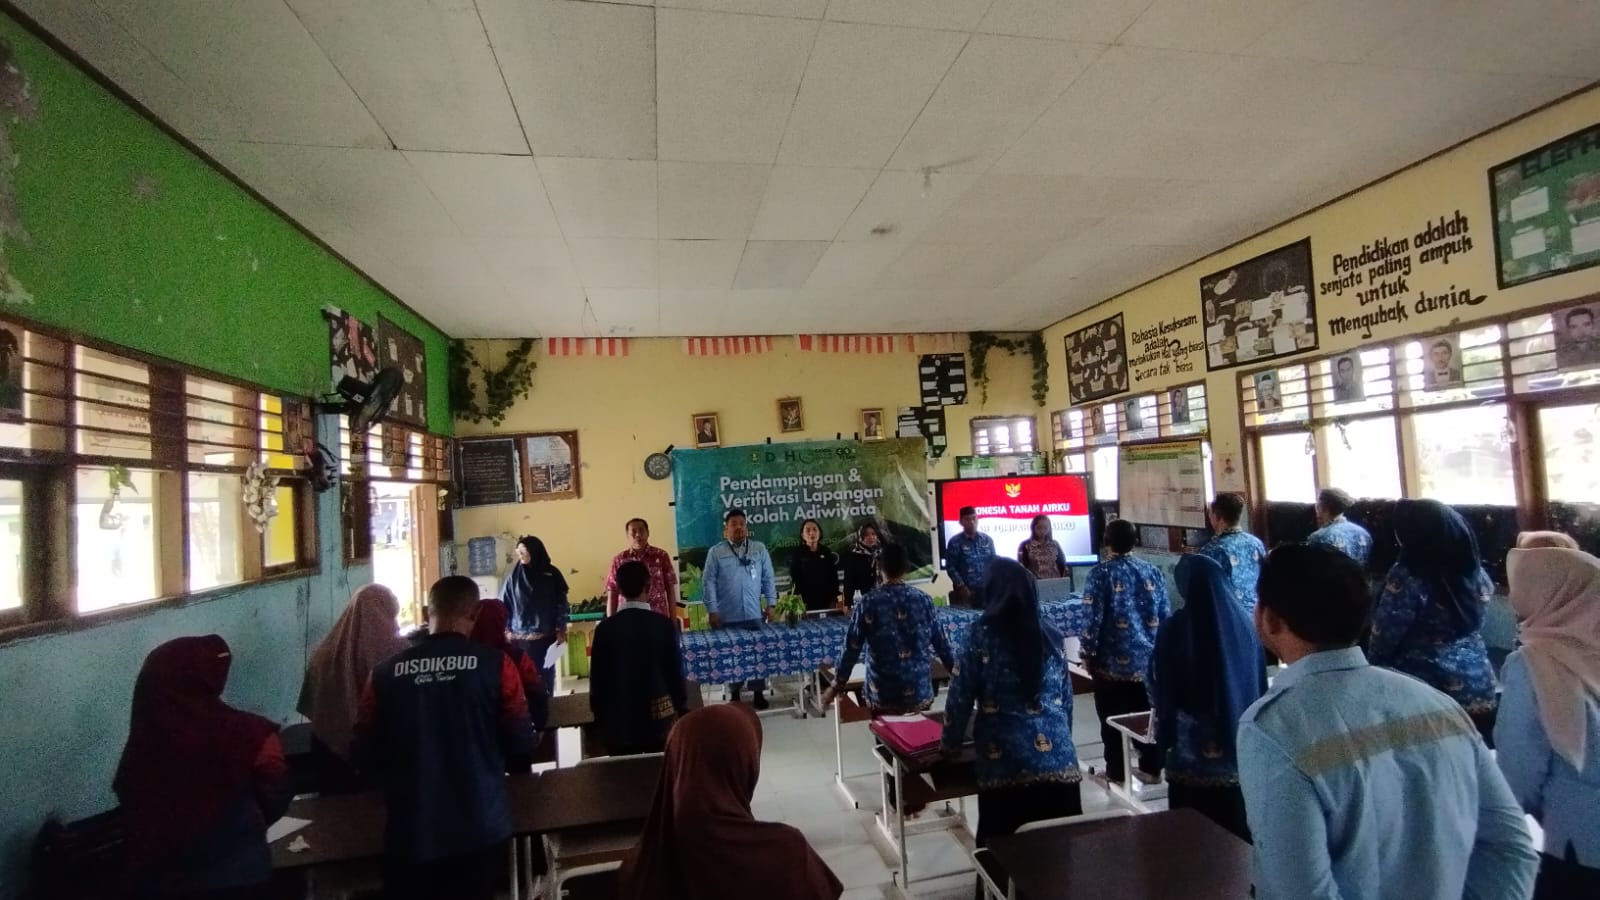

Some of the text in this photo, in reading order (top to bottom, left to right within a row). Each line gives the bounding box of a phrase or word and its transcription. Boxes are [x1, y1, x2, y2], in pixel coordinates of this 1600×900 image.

[1333, 209, 1469, 275] Pendidikan adalah
[1320, 235, 1473, 296] senjata paling ampuh
[1356, 275, 1410, 306] untuk
[1415, 284, 1488, 314] dunia
[1131, 324, 1158, 346] Rahasia
[720, 468, 861, 491] Pendampingan &
[720, 487, 884, 508] Verifikasi Lapangan
[1009, 504, 1040, 514] TANAH
[1042, 502, 1070, 513] AIRKU
[723, 504, 876, 525] kolah Adiwiyata
[394, 655, 478, 677] DISDIKBUD
